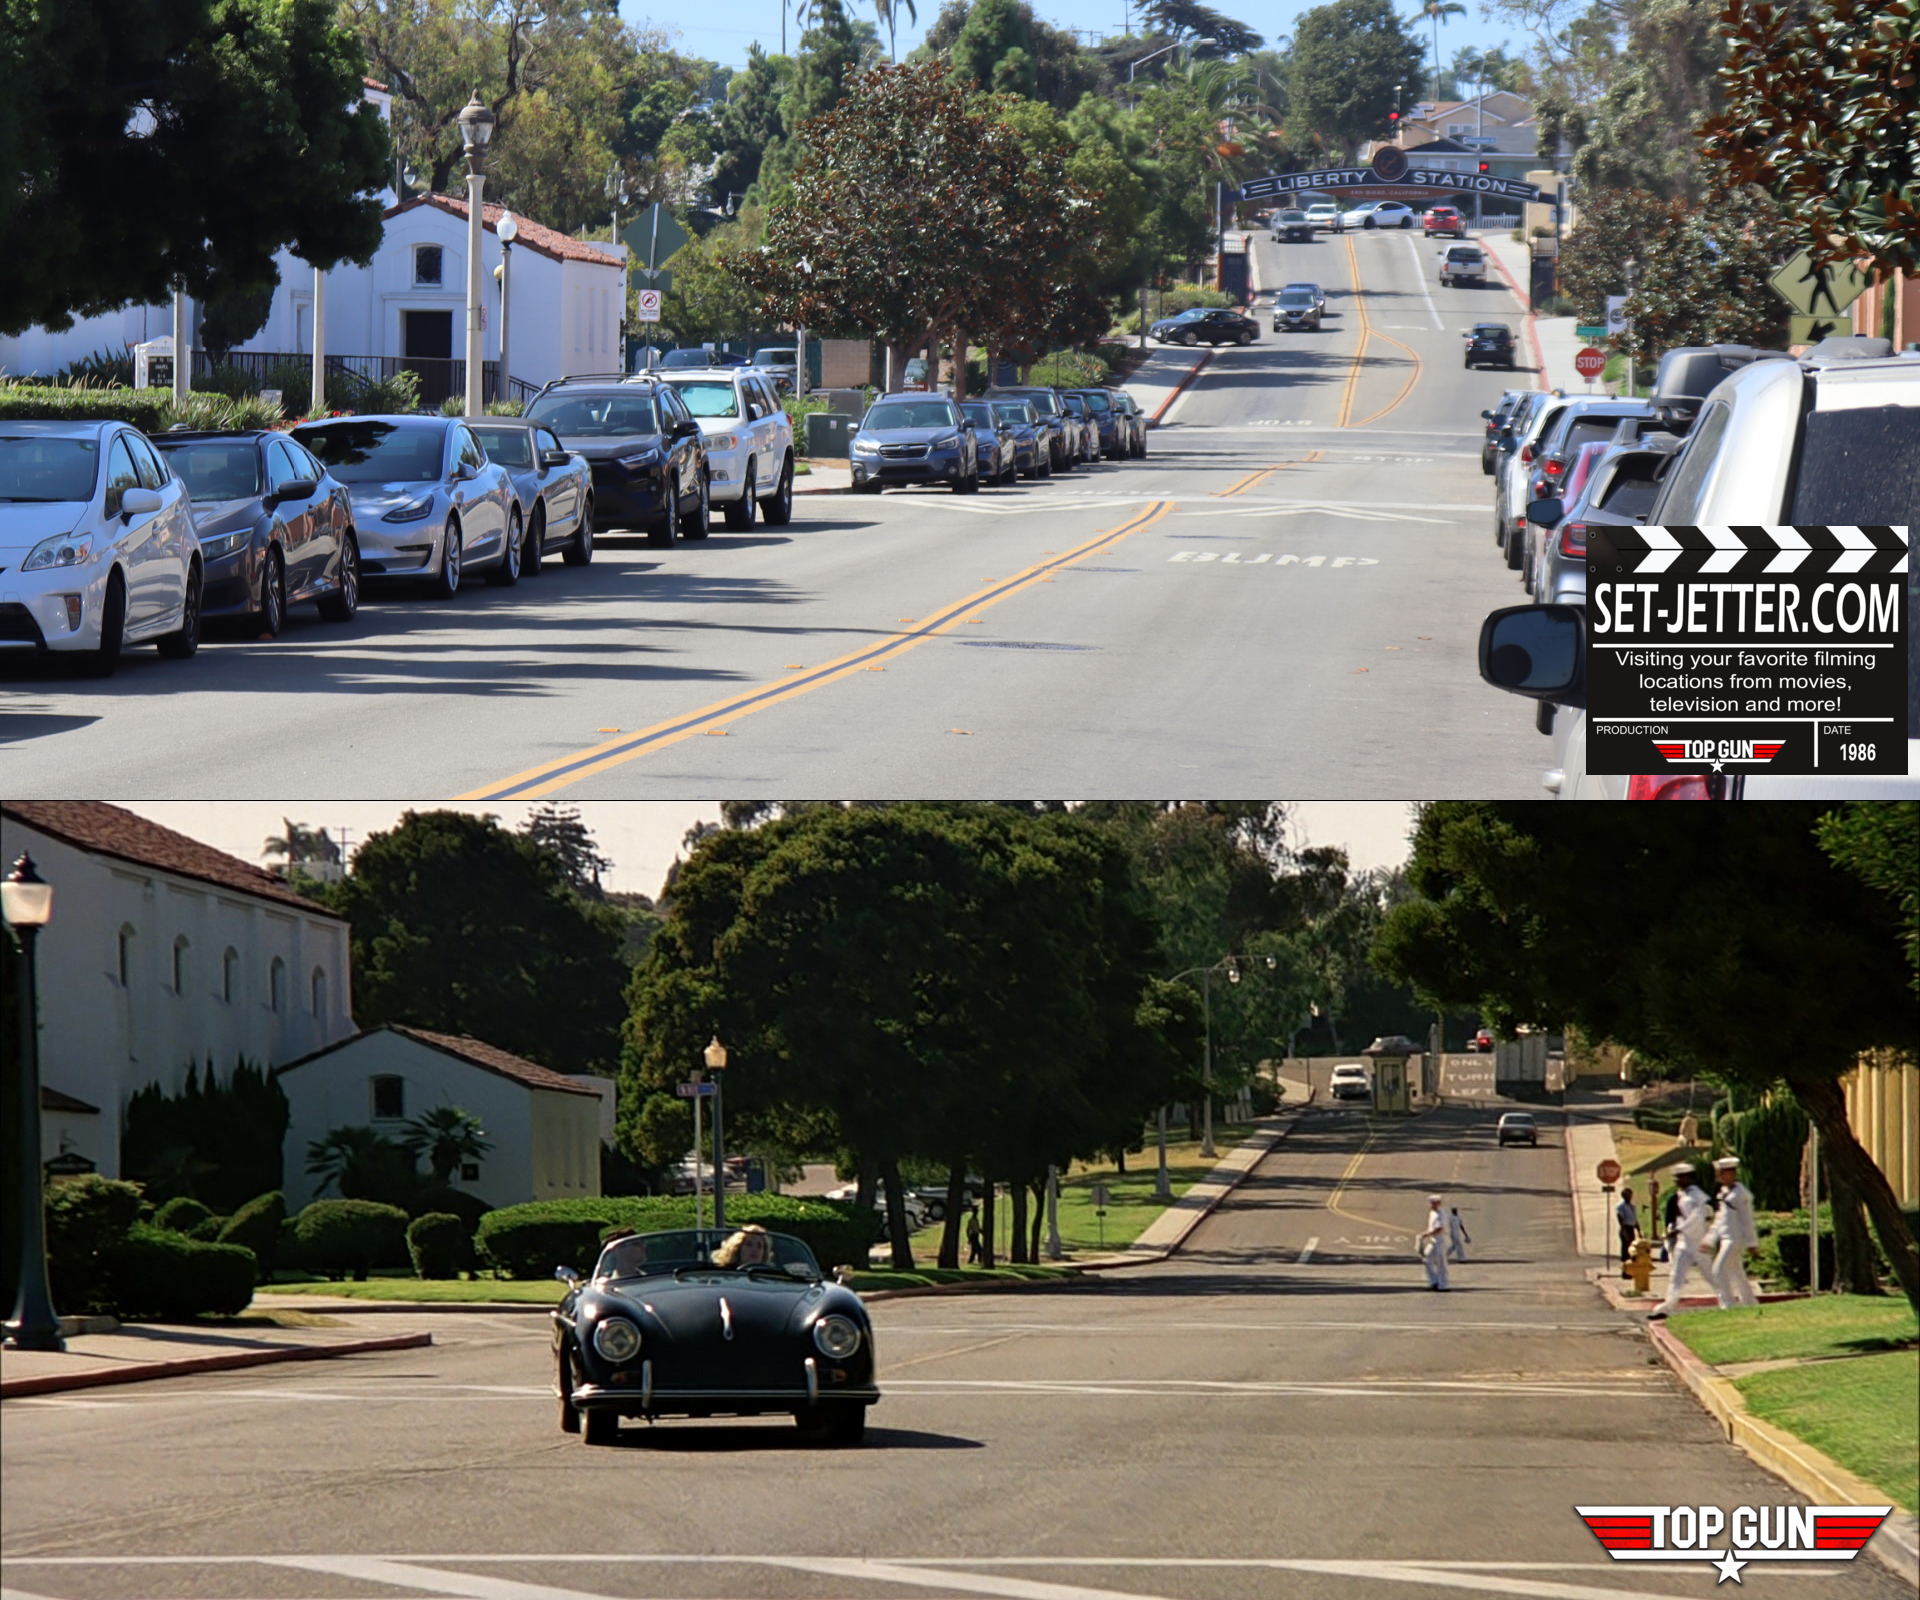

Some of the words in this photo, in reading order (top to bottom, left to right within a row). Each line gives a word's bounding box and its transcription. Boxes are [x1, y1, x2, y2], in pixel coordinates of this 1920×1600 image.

[1277, 170, 1368, 192] LIBERTY
[1413, 170, 1507, 193] STATION
[1577, 357, 1605, 369] STOP
[1167, 551, 1380, 567] BUMP
